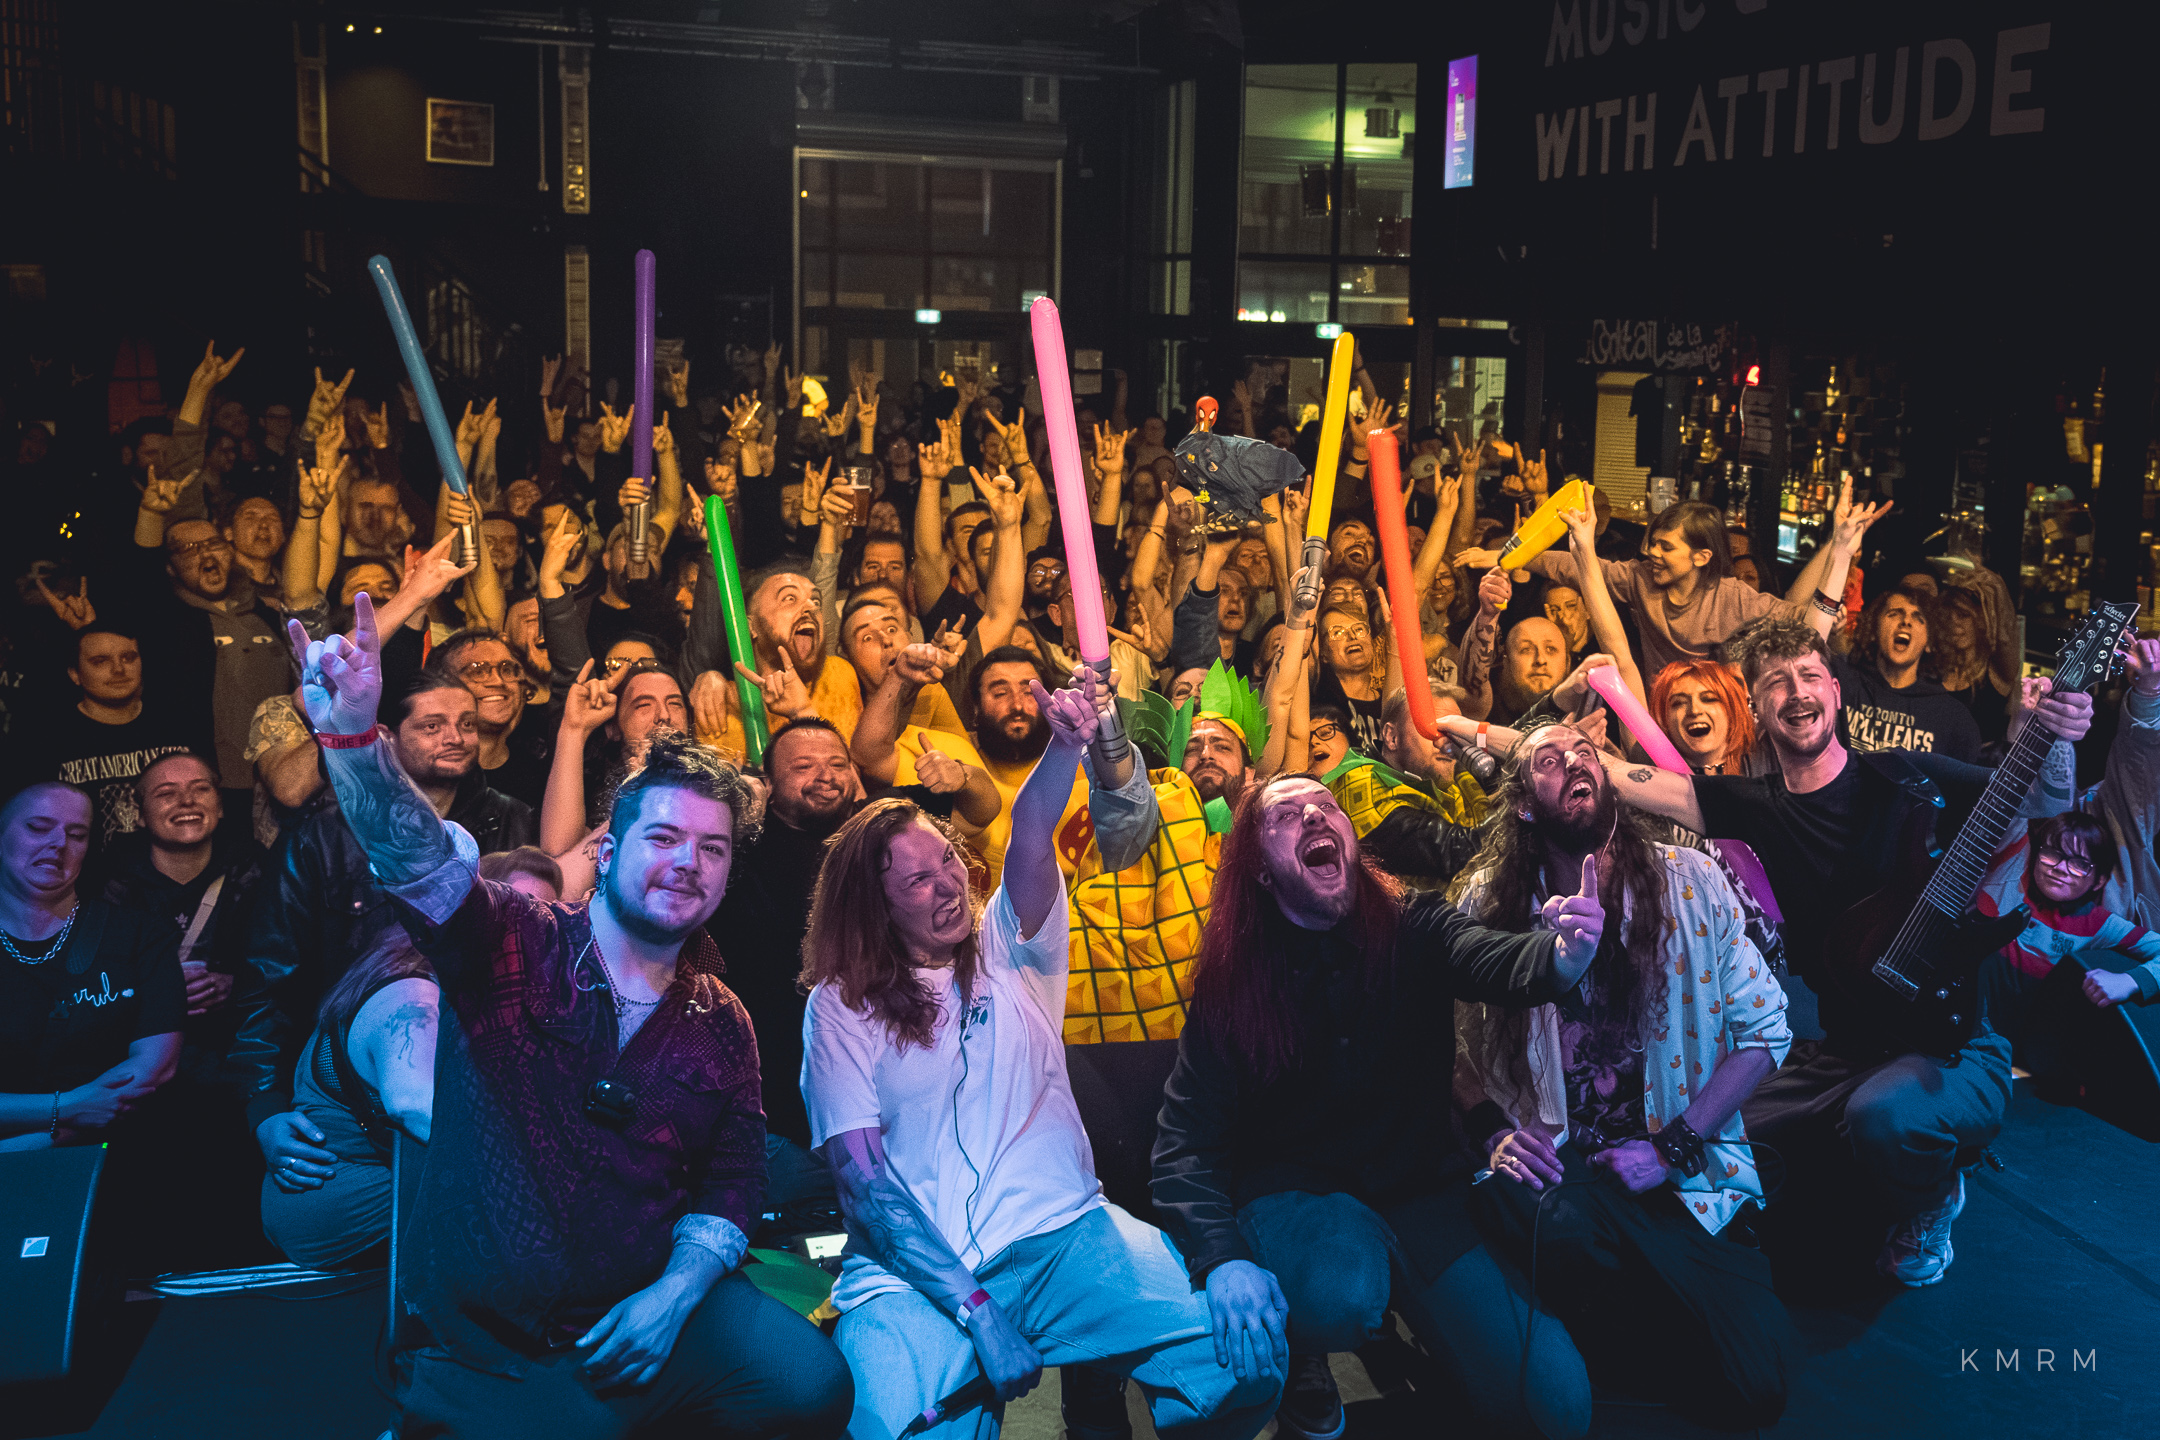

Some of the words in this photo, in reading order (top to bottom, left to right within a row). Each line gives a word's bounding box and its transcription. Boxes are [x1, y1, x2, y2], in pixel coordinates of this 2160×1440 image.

[1545, 0, 1706, 67] MUSIC
[1535, 92, 1657, 182] WITH
[1673, 22, 2052, 167] ATTITUDE
[1861, 704, 1916, 726] TORONTO
[1884, 722, 1935, 753] LEAFS
